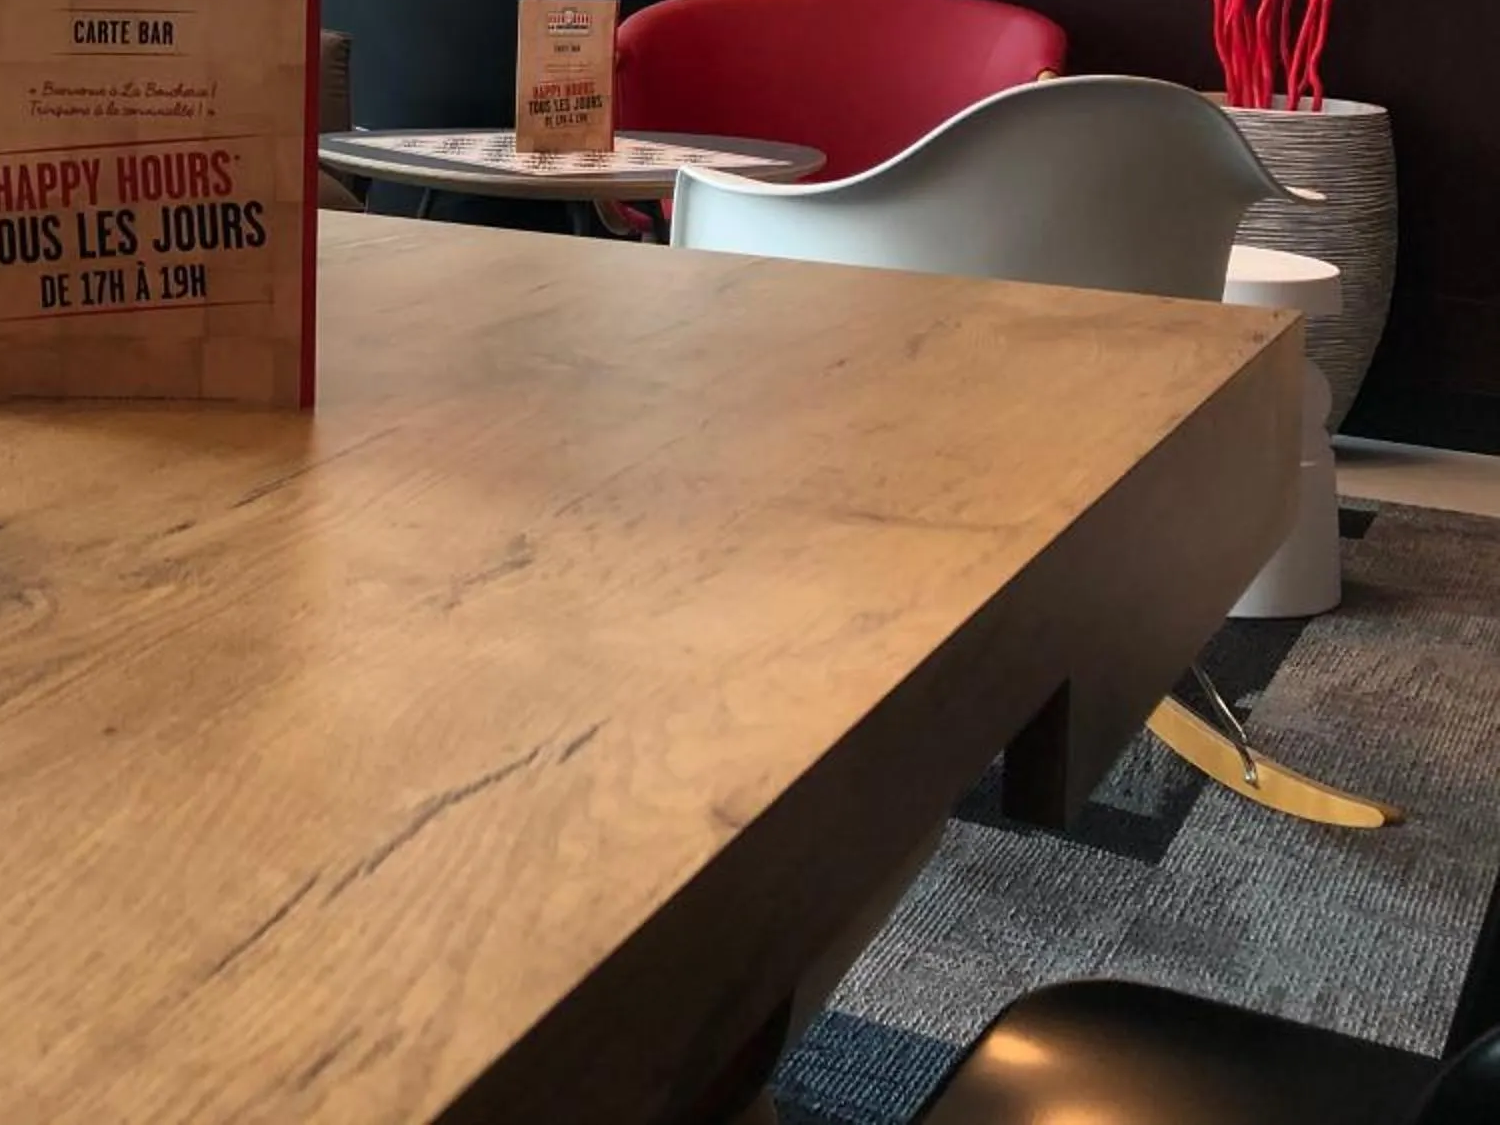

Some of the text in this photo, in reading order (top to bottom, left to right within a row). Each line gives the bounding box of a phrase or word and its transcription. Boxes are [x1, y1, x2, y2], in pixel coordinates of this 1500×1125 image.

[73, 20, 174, 46] CARTE BAR
[77, 209, 138, 260] LES
[153, 201, 266, 253] JOURS
[41, 261, 207, 308] DE 17H À 19H
